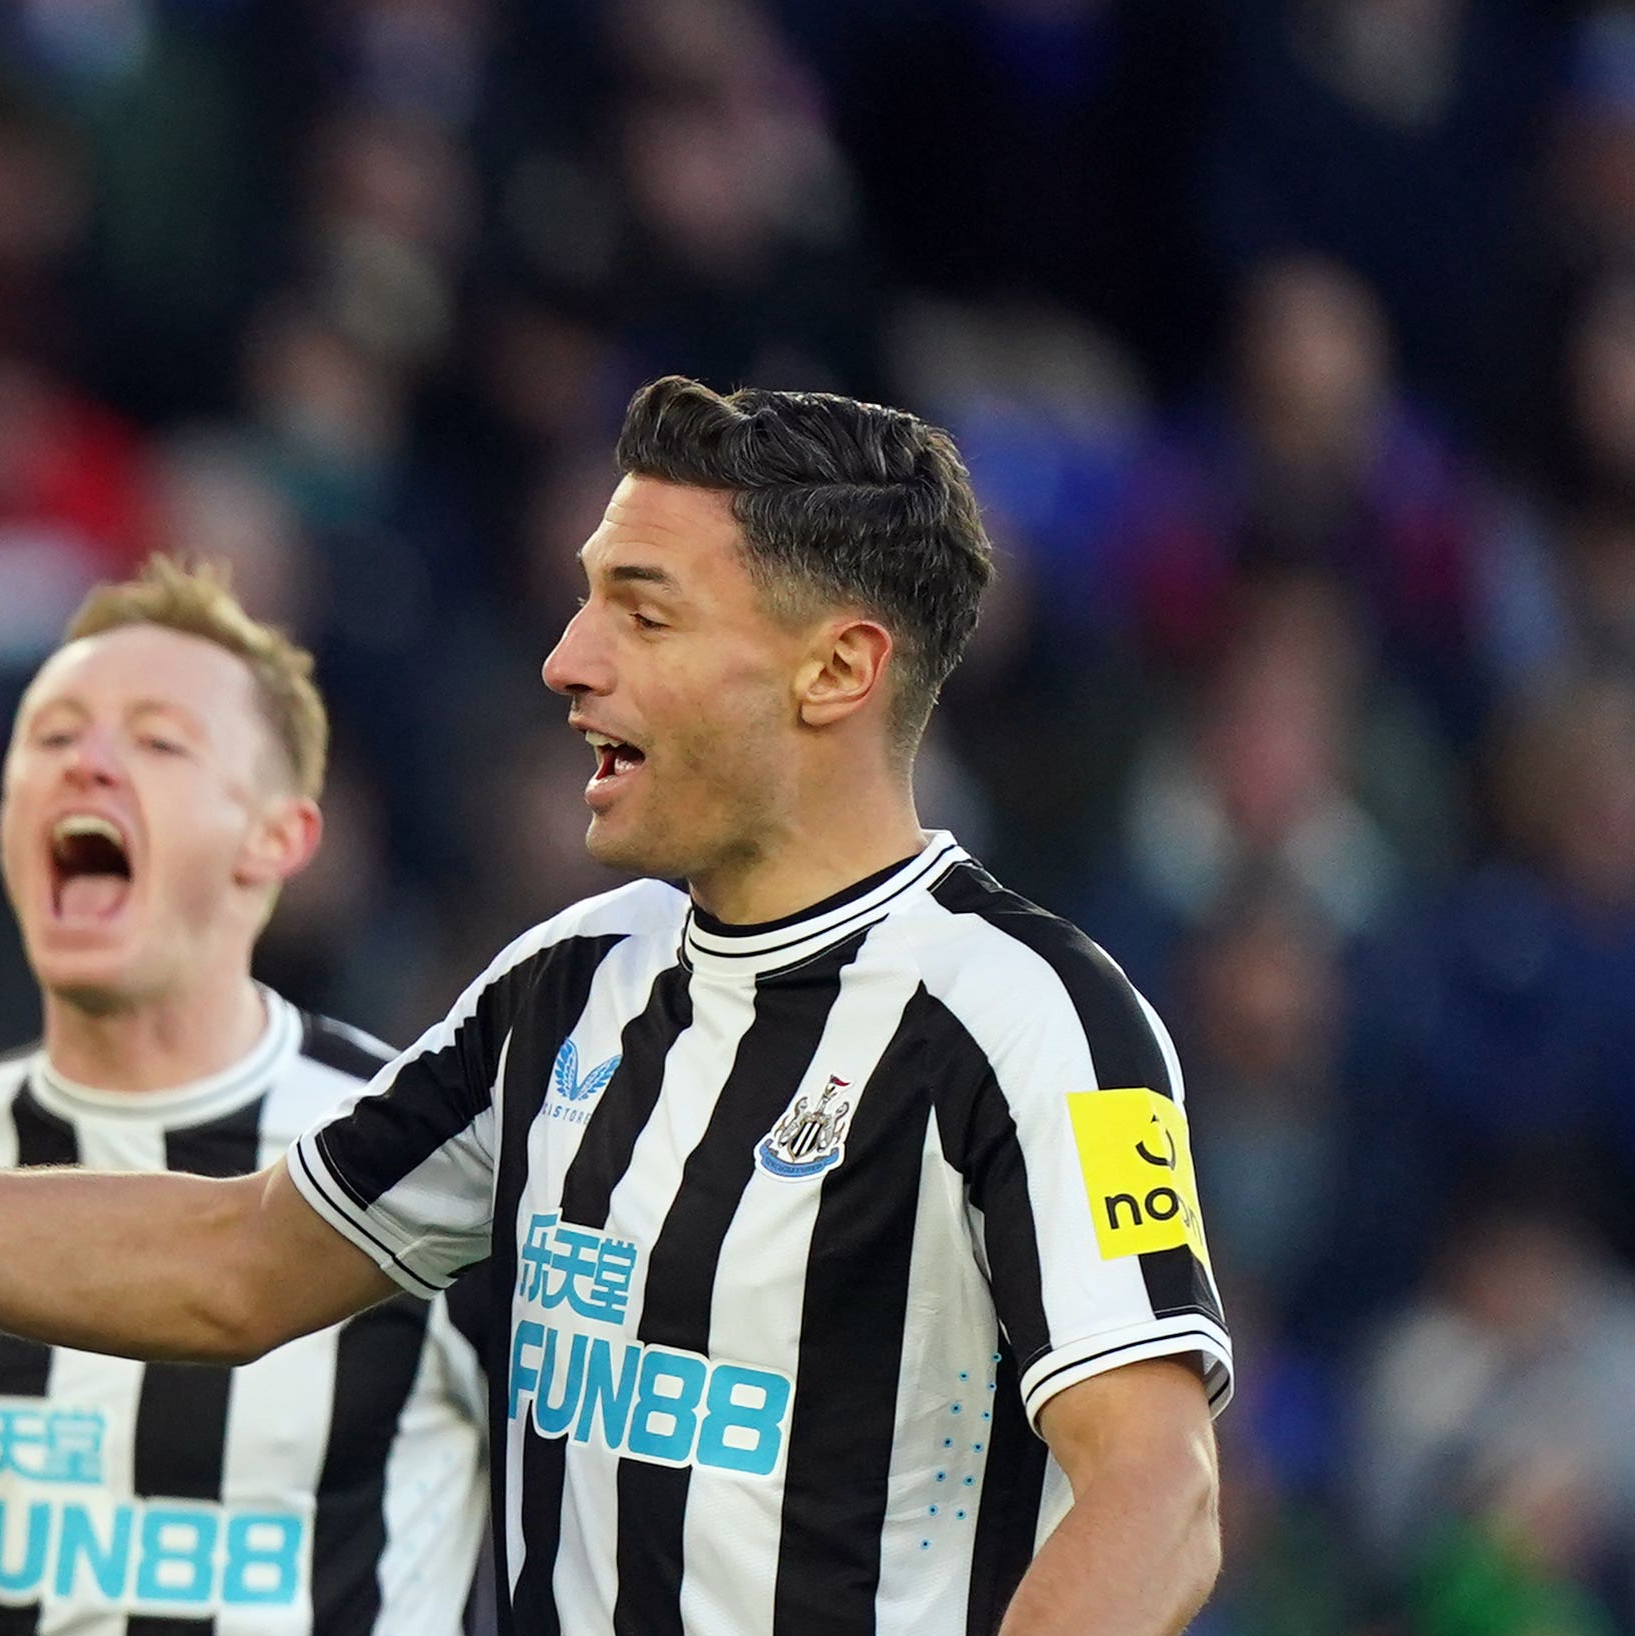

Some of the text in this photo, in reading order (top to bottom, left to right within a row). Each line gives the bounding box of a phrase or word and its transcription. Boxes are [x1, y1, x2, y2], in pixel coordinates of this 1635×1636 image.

[520, 1213, 637, 1325] 乐天堂
[508, 1320, 792, 1476] FUN88
